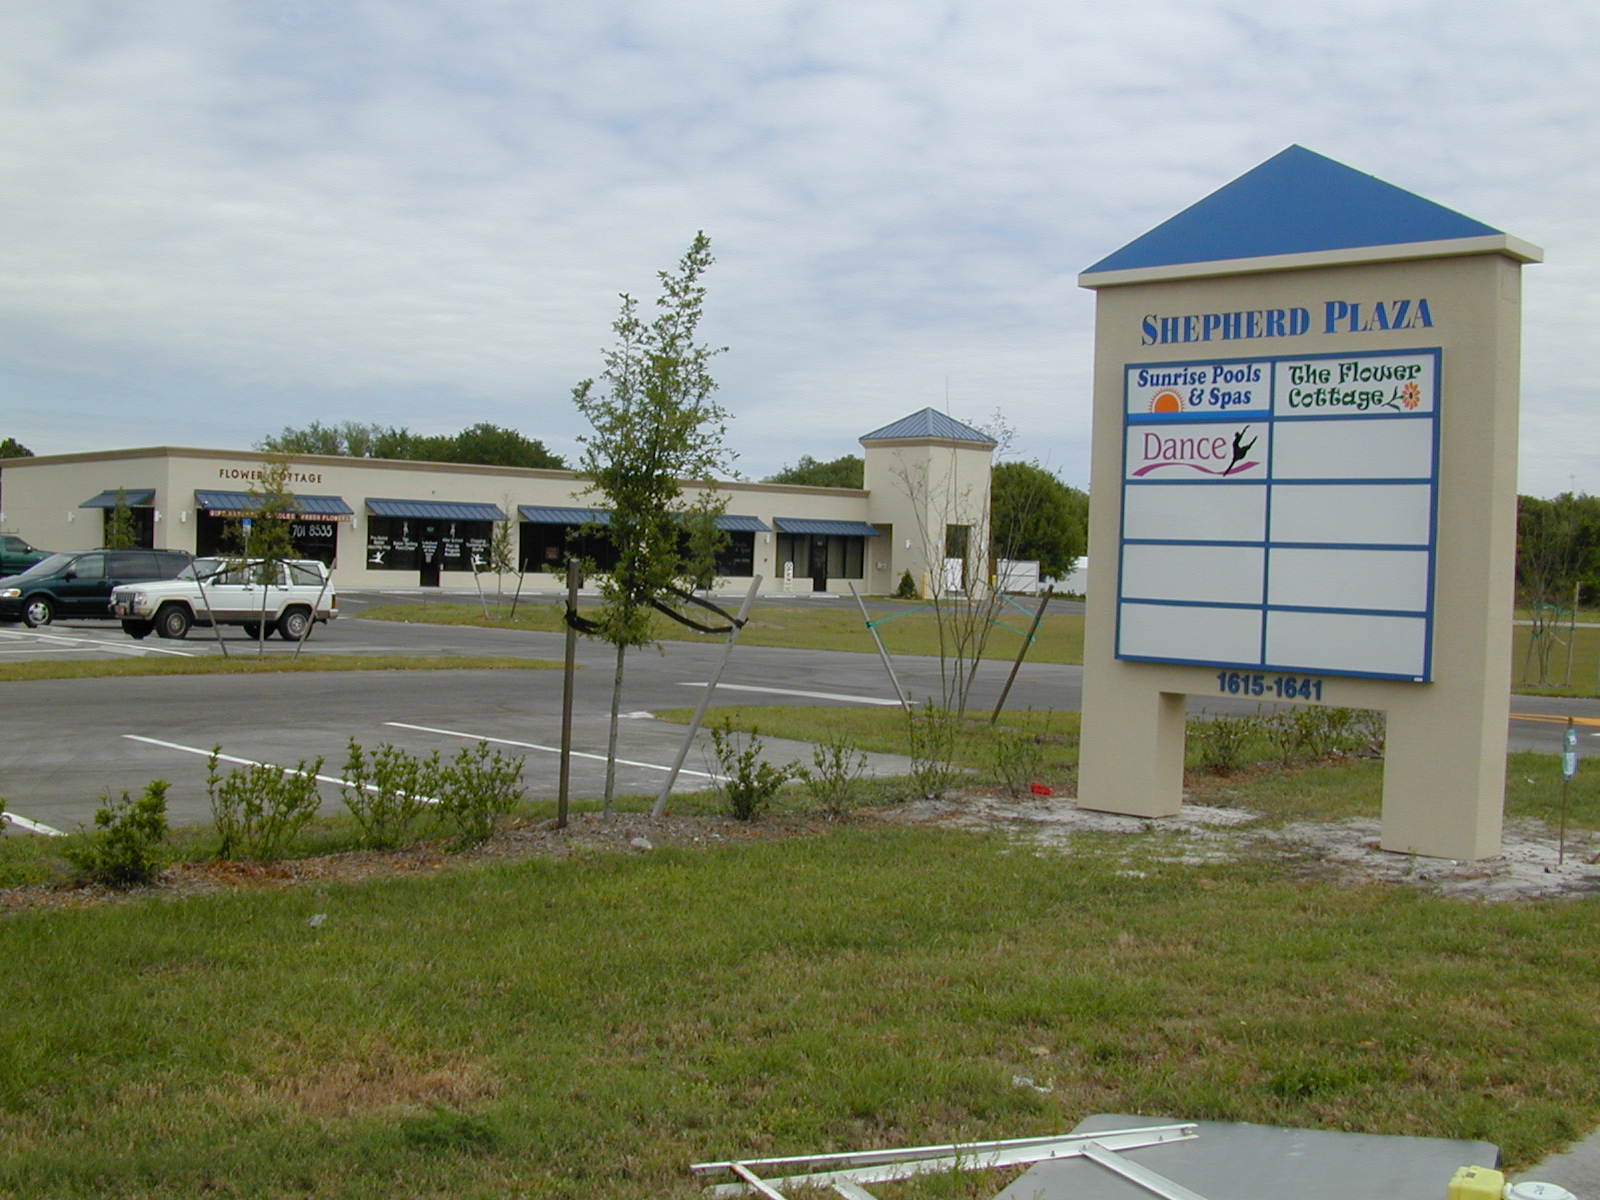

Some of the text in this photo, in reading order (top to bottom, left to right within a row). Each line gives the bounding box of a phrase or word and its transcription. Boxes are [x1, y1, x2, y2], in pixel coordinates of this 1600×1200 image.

[1141, 297, 1434, 346] SHEPHERD PLAZA
[1137, 363, 1262, 387] Sunrise Pools
[1288, 361, 1422, 386] The Flower
[1188, 387, 1252, 409] & Spas
[1288, 386, 1384, 411] Cottage
[1143, 432, 1227, 461] Dance
[1217, 671, 1322, 701] 1615-1641
